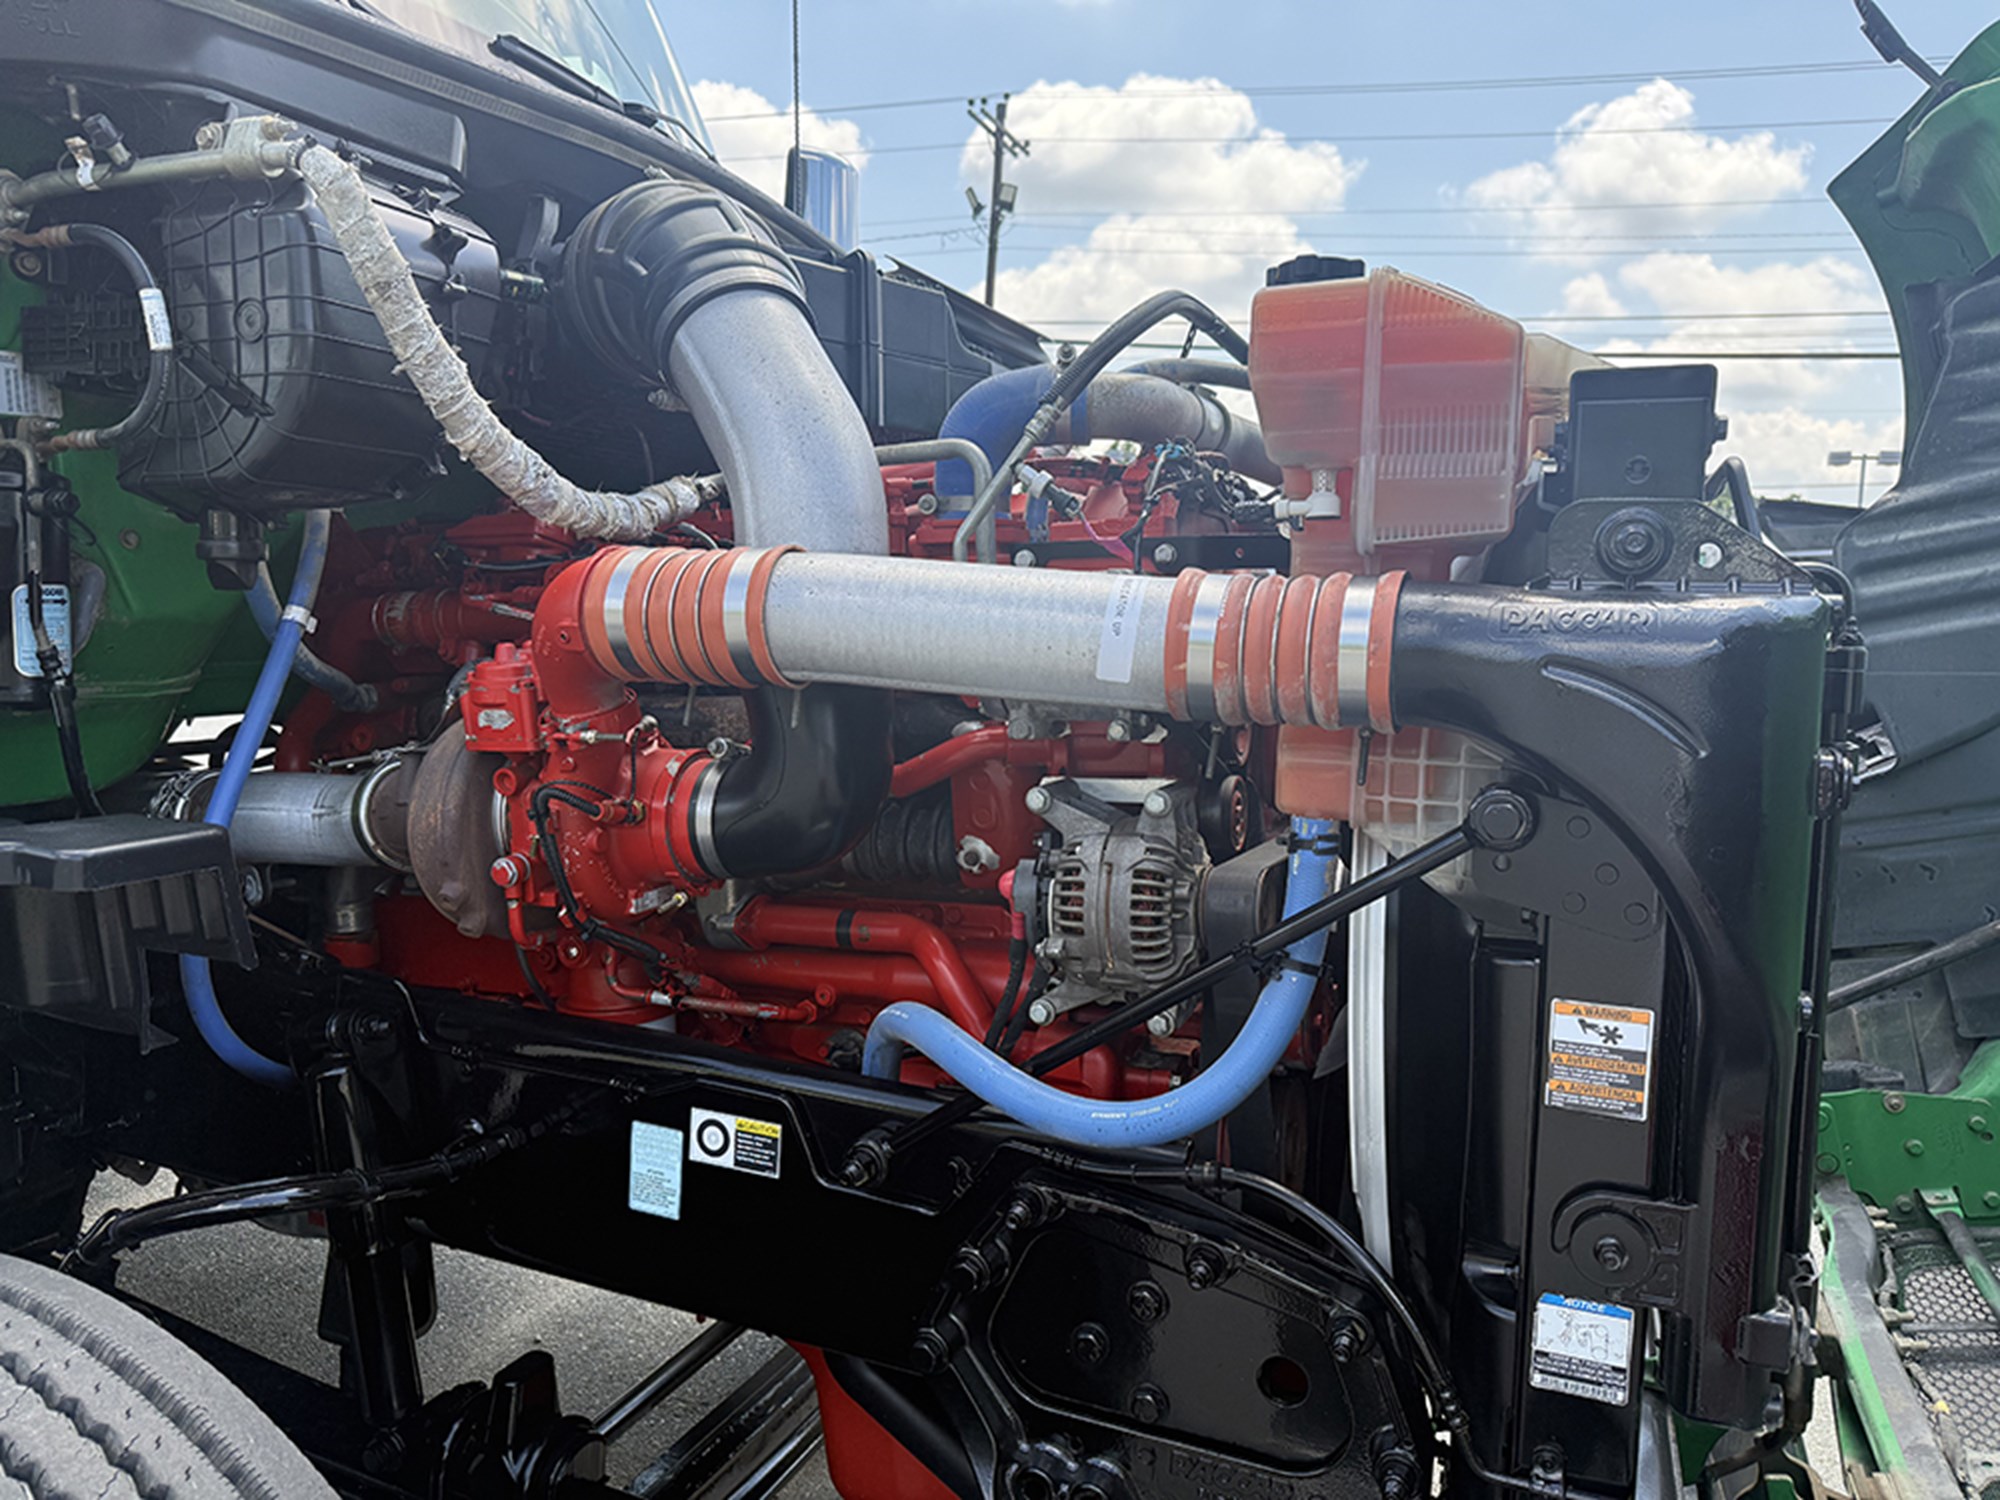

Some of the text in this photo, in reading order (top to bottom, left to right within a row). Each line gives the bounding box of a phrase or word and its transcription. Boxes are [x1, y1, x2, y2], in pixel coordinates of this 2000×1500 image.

[1501, 604, 1651, 634] PACCAR
[1586, 1005, 1632, 1020] WARNING
[1563, 1299, 1604, 1312] NOTICE
